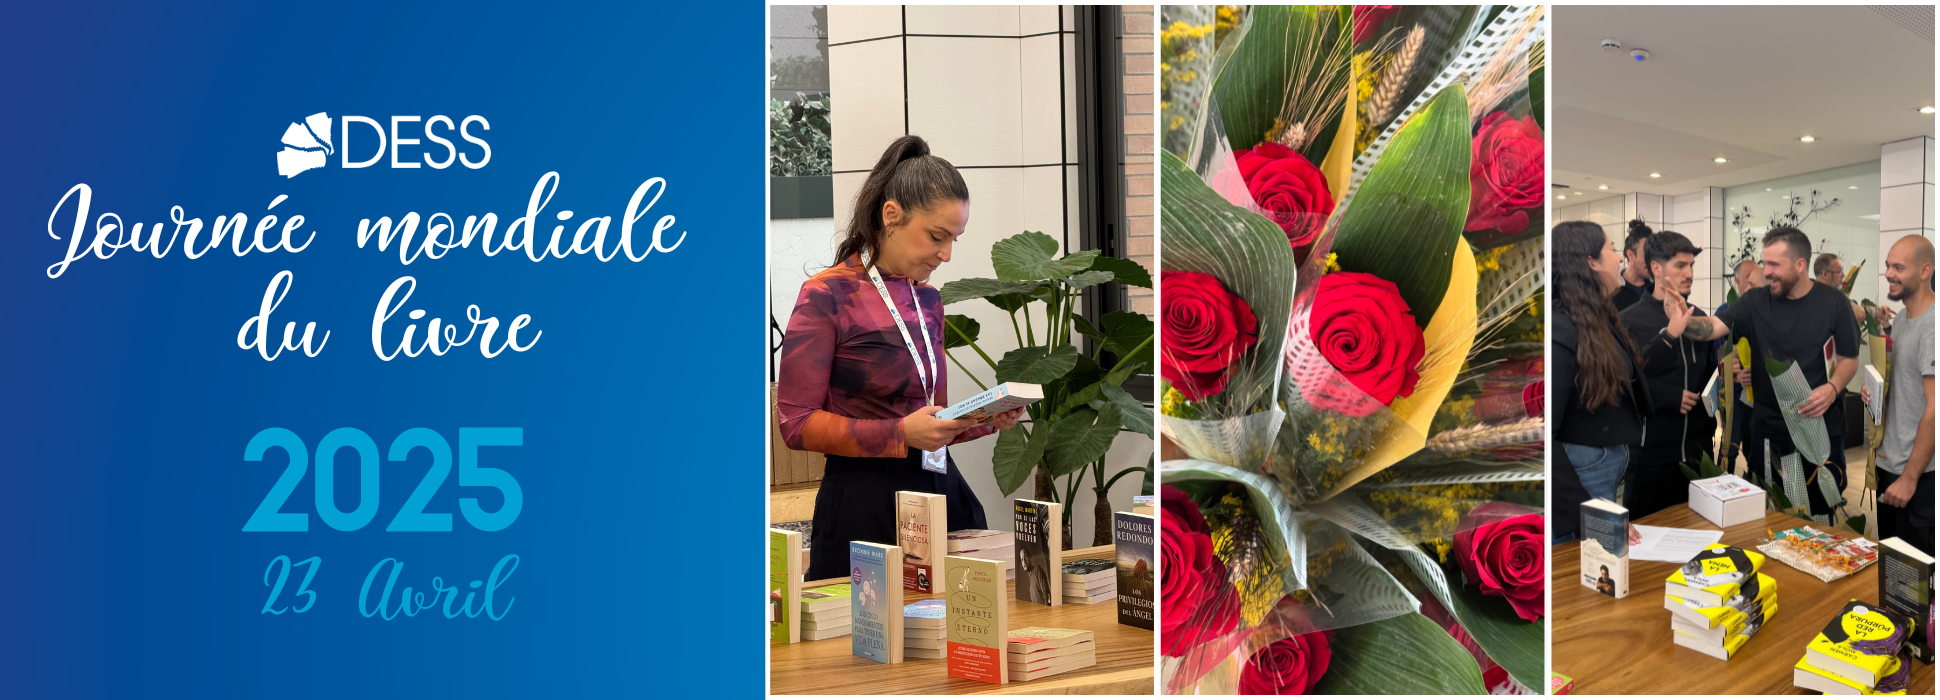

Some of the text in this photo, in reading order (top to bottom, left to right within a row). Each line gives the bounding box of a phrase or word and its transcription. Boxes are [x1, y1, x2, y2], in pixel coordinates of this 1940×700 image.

[876, 281, 889, 299] DESS
[894, 314, 906, 332] DESS
[900, 520, 928, 534] PACIENTE
[1016, 520, 1036, 534] VOCES
[1117, 520, 1152, 534] DOLORES
[900, 534, 928, 545] SILENCIOSA
[1016, 532, 1036, 543] VUELVEN
[1117, 531, 1153, 545] REDONDO
[1709, 560, 1730, 569] NENA
[952, 607, 992, 619] INSTANTE
[1133, 607, 1153, 620] ÁNGEL
[957, 624, 988, 634] ETERNO
[1850, 614, 1891, 632] PÚRPURA
[1856, 624, 1874, 633] RED
[1830, 647, 1857, 660] CARMEN
[1838, 645, 1857, 654] MOLA
